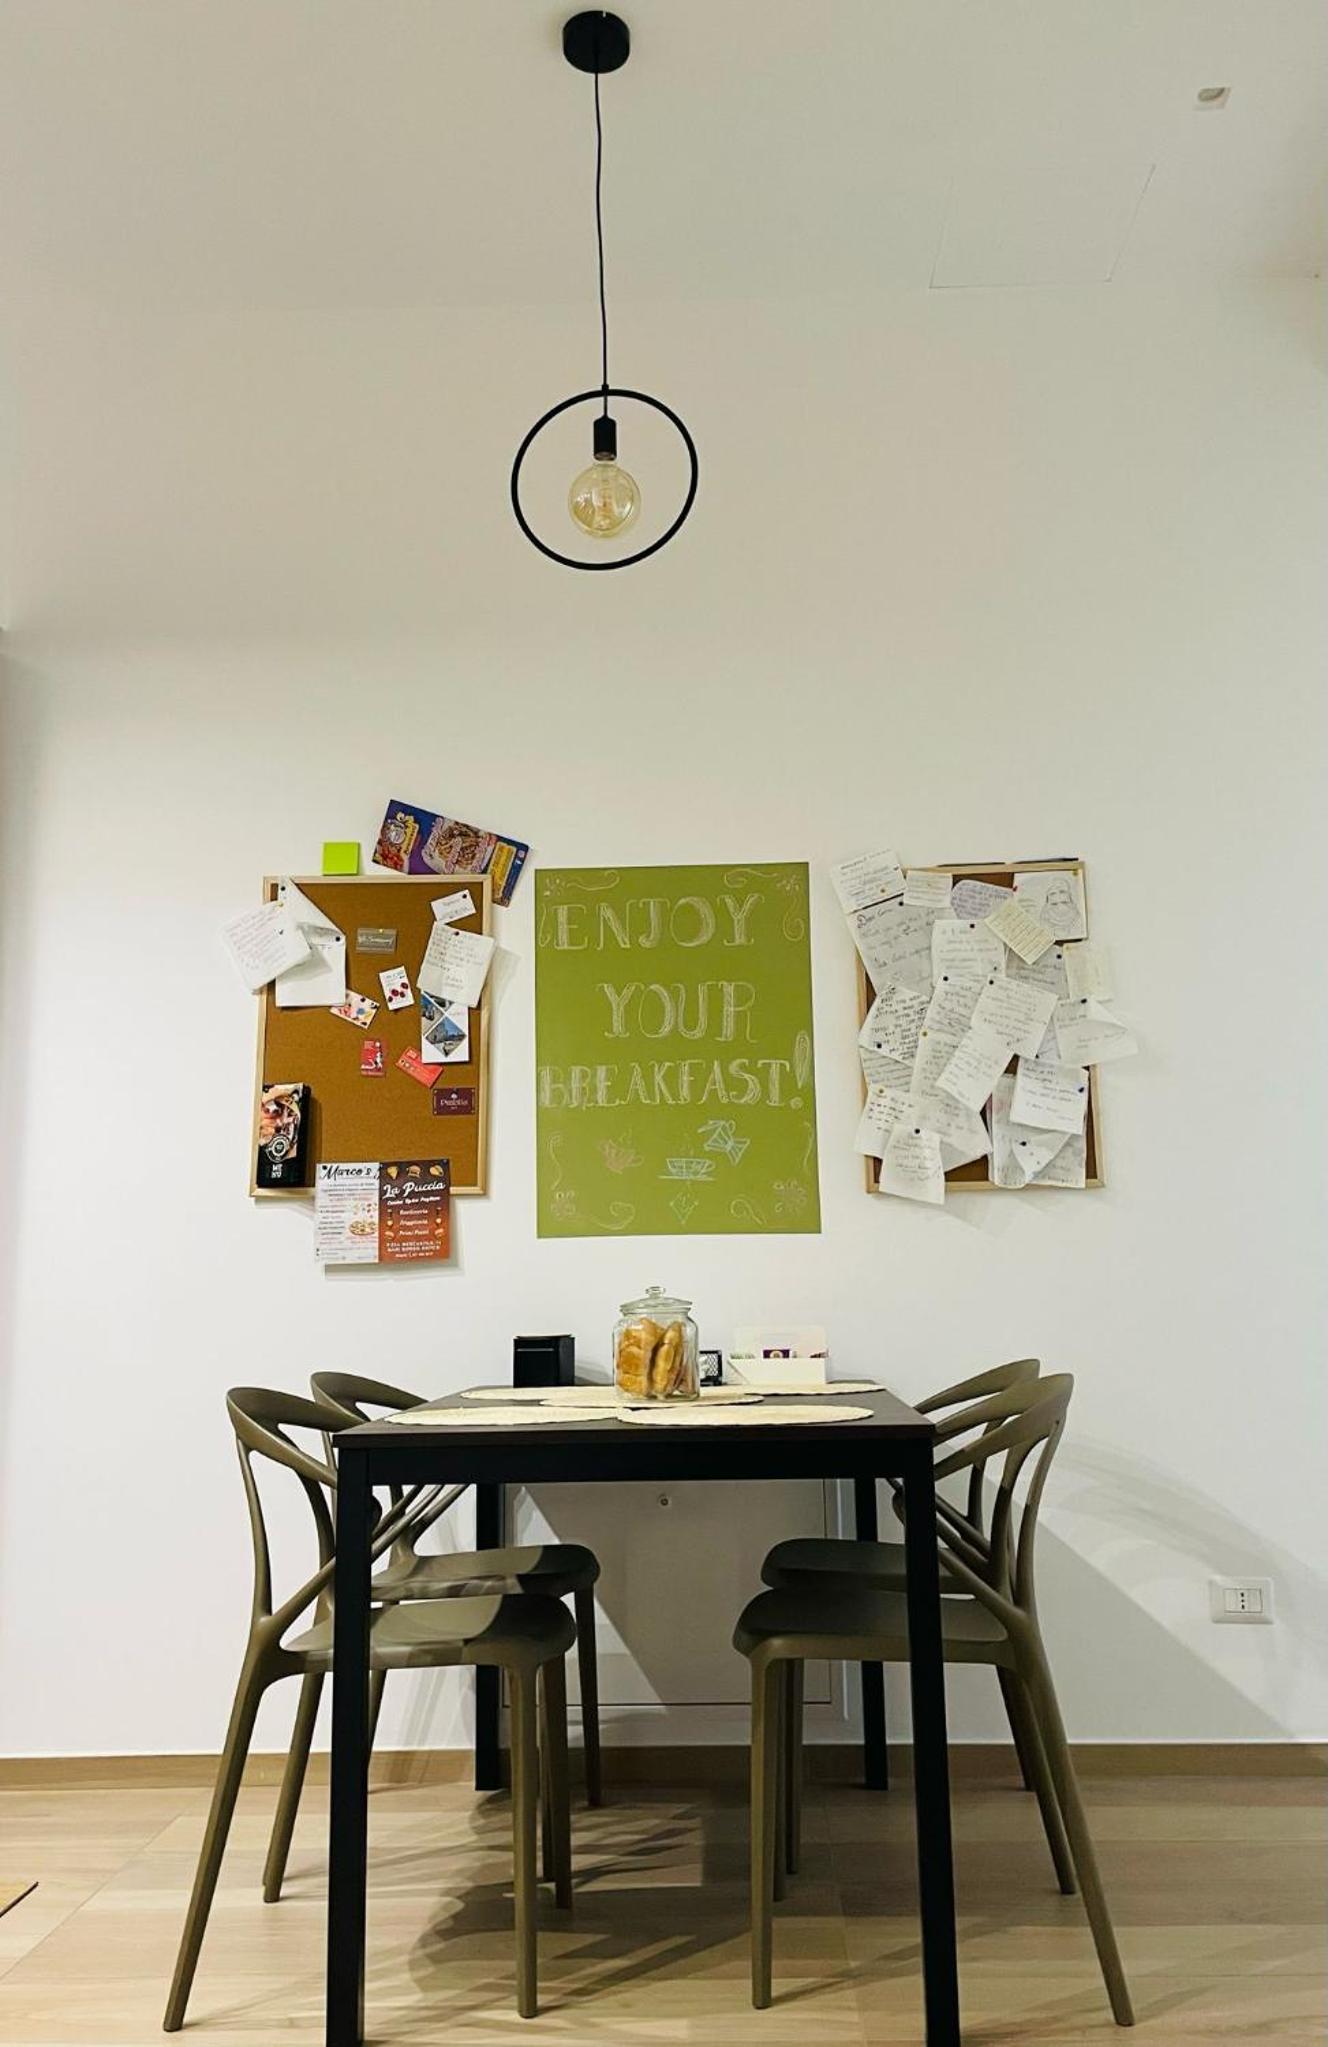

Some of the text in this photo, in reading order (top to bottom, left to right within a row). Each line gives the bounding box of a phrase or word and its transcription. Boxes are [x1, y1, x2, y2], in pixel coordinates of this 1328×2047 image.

[552, 894, 765, 951] ENJOY
[598, 980, 758, 1043] YOUR
[540, 1029, 812, 1110] BREAKFAST!
[322, 1165, 372, 1181] Marco's
[382, 1184, 400, 1200] La
[402, 1181, 446, 1198] Puccia
